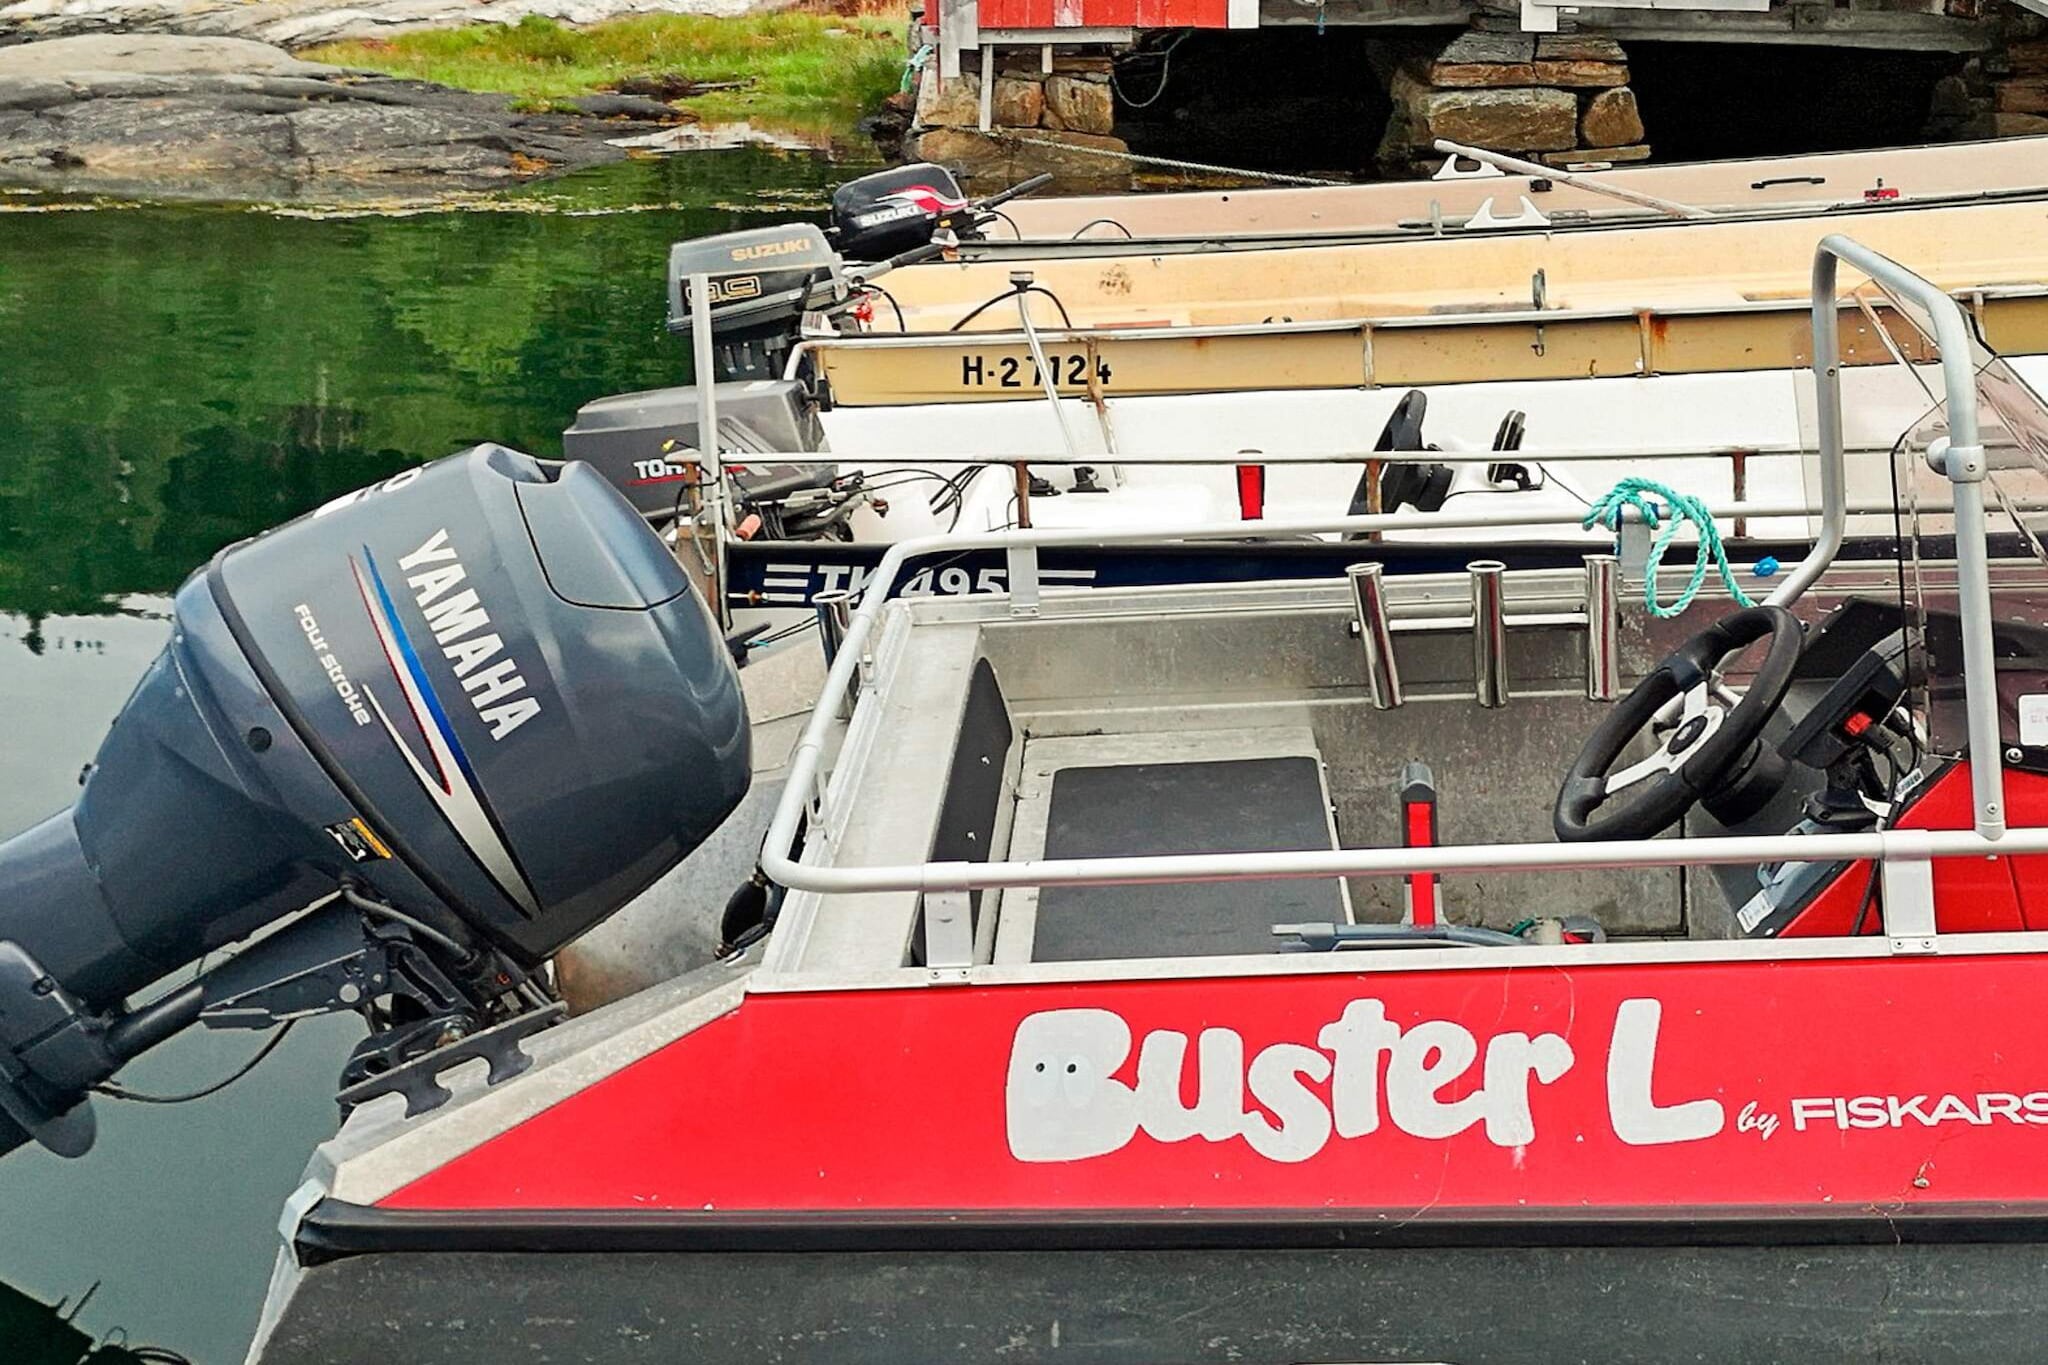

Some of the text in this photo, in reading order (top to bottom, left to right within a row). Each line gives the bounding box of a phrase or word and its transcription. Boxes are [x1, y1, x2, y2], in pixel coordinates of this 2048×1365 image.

[860, 204, 919, 228] SUZUKI
[731, 238, 811, 261] SUZUKI
[900, 567, 1007, 596] 495
[398, 528, 542, 741] YAMAHA
[1006, 998, 2048, 1163] Buster L by FISKARS
